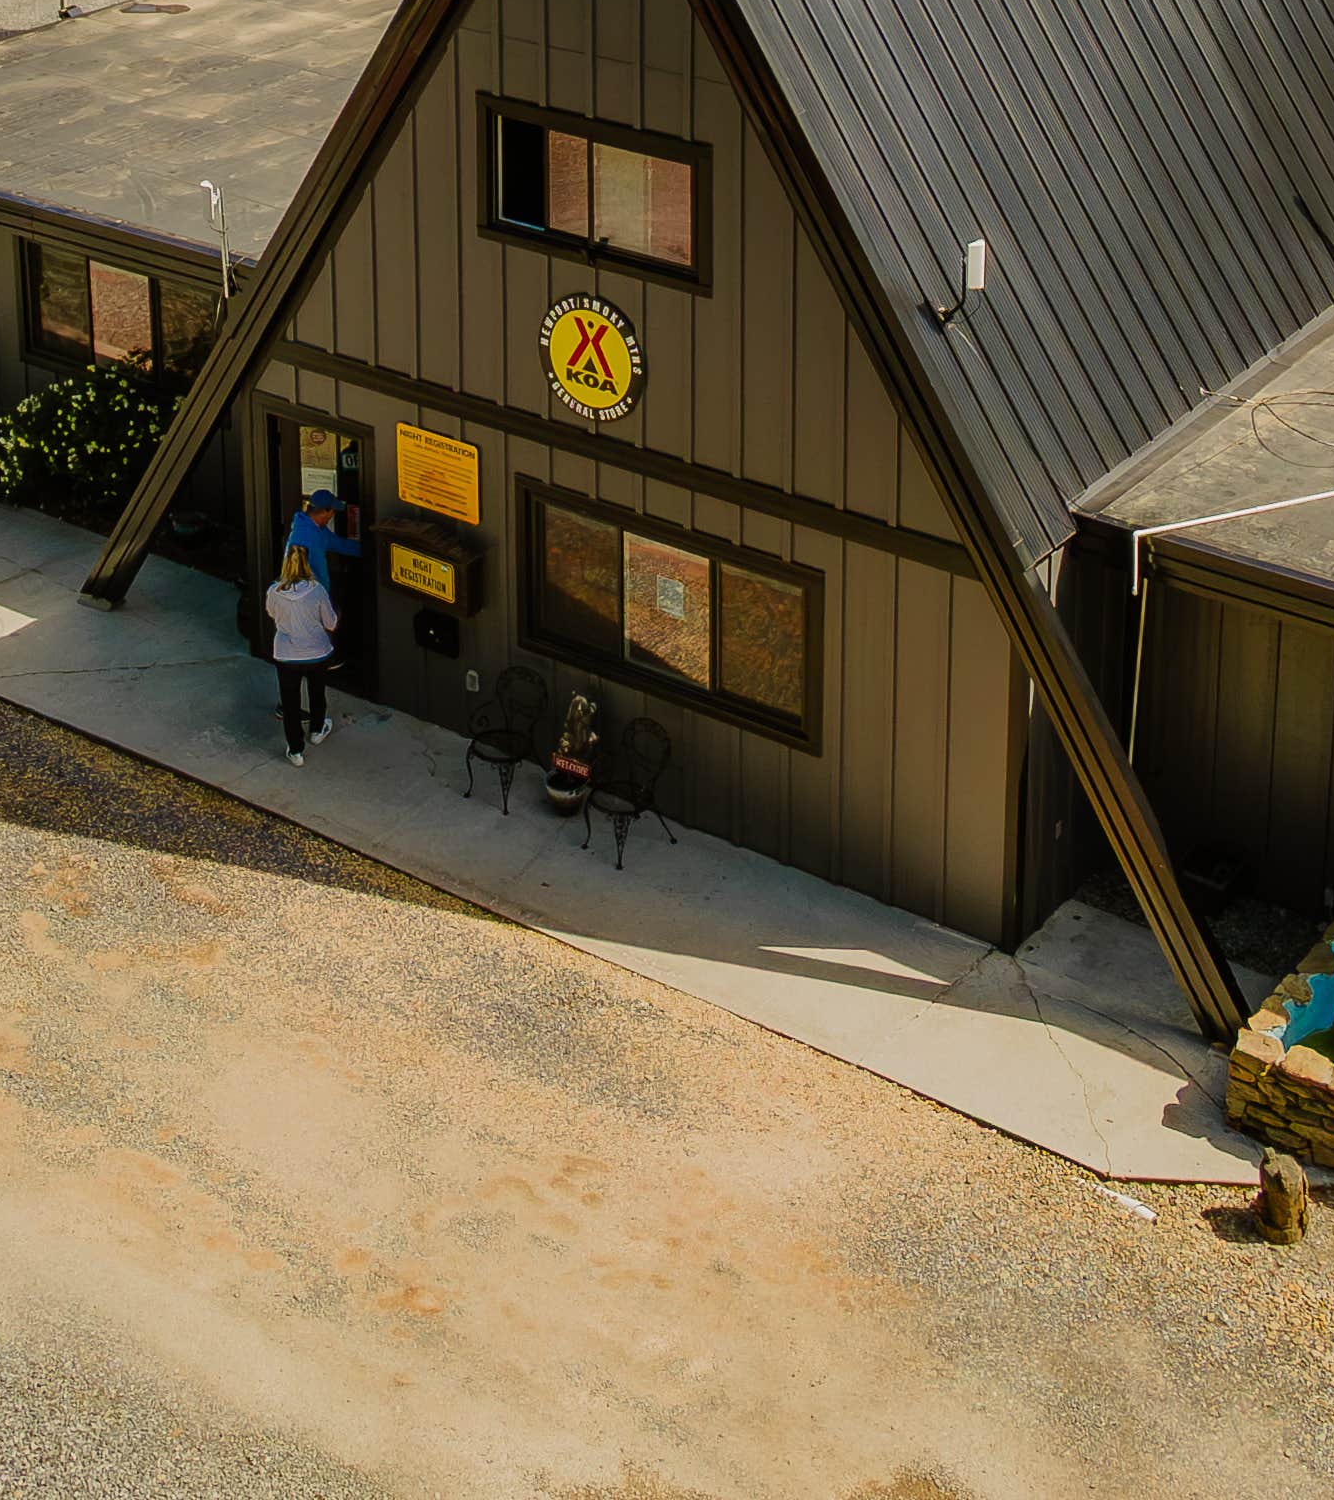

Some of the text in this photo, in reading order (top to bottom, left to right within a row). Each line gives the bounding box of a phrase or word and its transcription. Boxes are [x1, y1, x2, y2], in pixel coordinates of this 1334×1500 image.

[566, 367, 618, 396] KOA
[551, 381, 628, 420] GENERAL STORE
[399, 428, 422, 444] NIGHT
[424, 436, 475, 459] REGISTRATION
[400, 566, 446, 594] REGISTRATION
[412, 558, 432, 574] NIGHT
